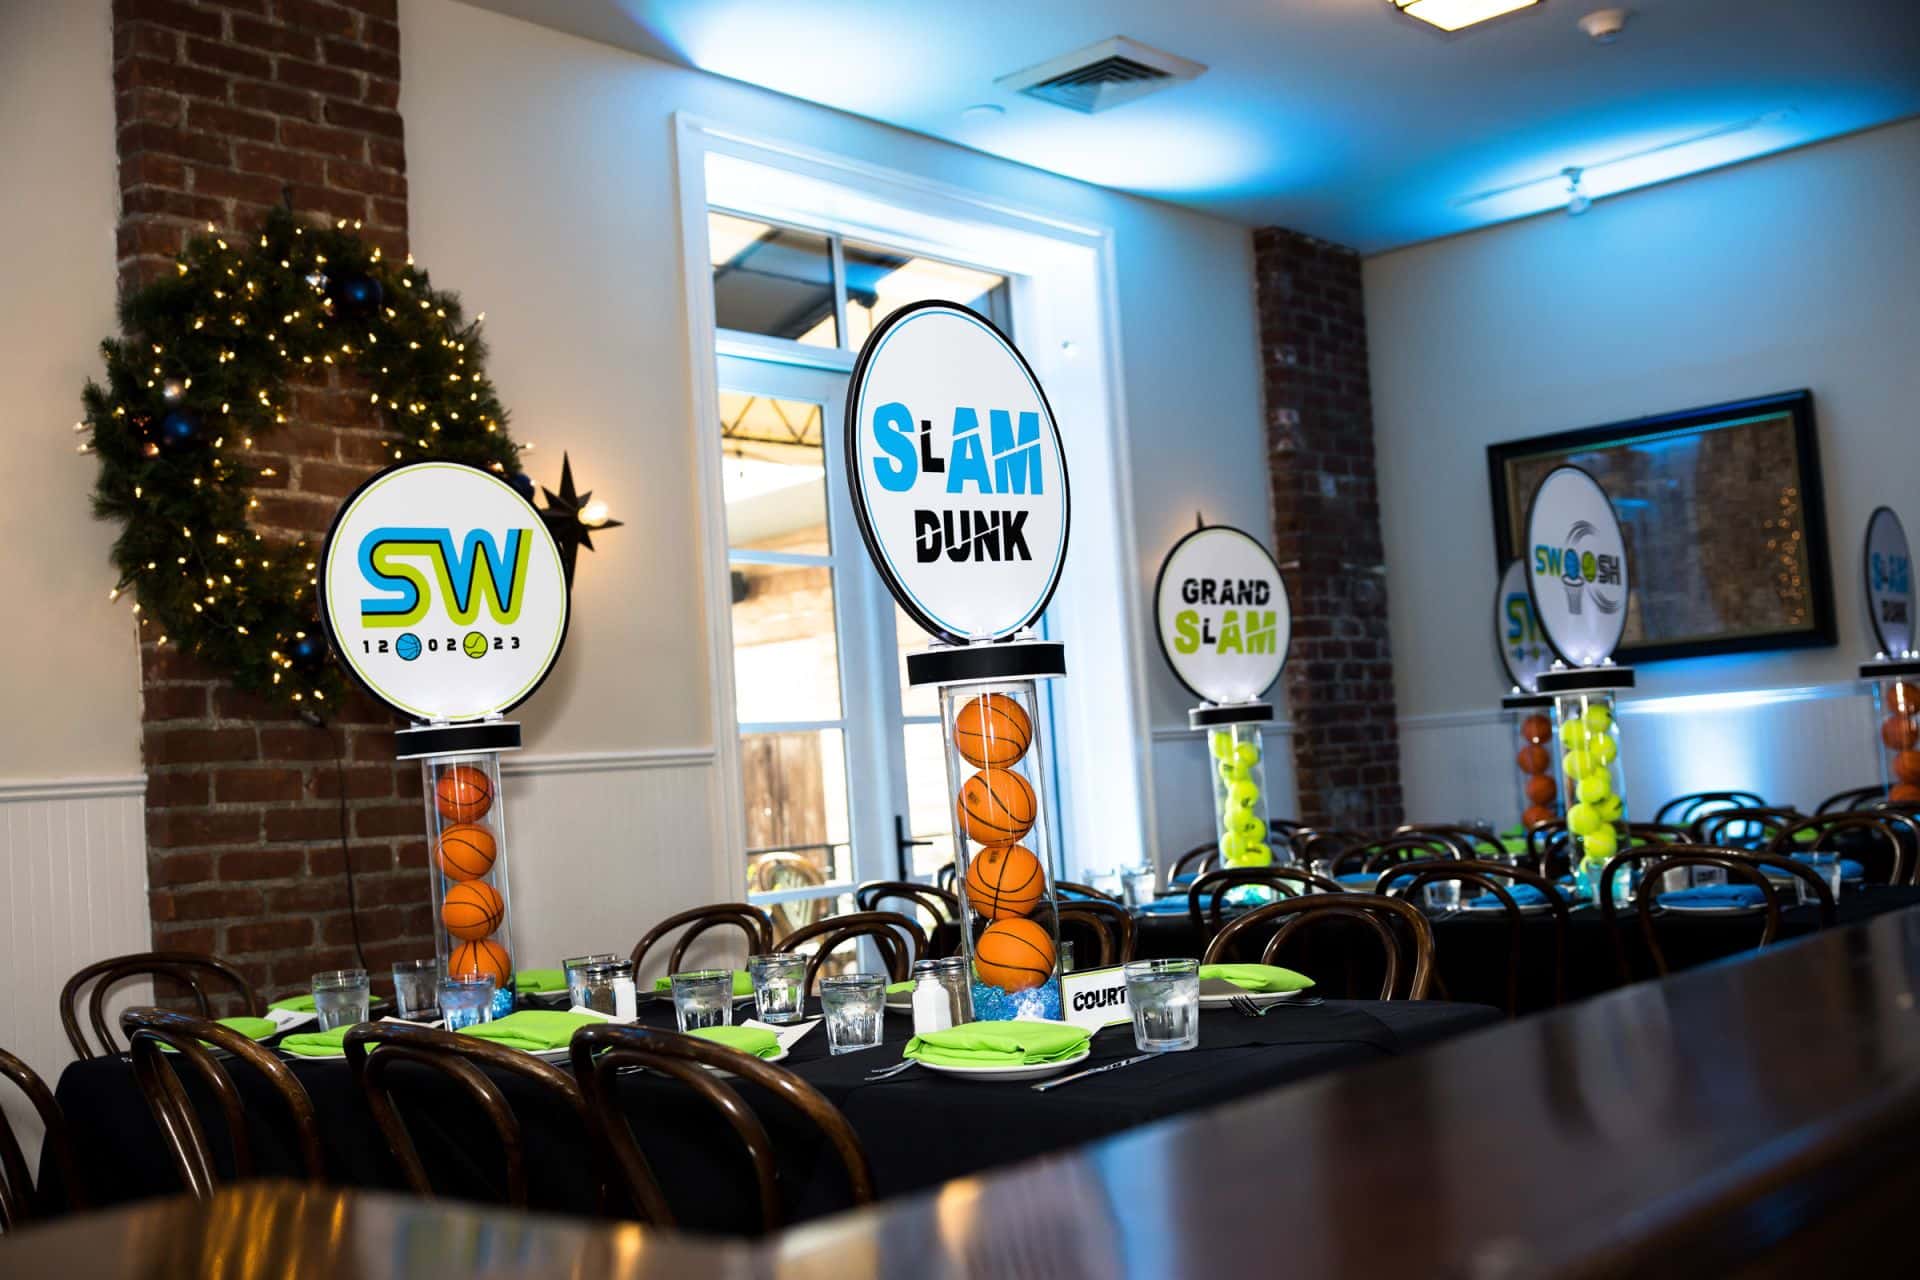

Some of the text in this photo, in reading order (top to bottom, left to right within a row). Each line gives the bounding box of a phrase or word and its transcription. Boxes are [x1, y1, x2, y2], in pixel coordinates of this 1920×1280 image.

[872, 402, 1044, 495] SLAM
[914, 510, 1033, 563] DUNK
[358, 527, 533, 628] SW
[1182, 578, 1270, 606] GRAND
[1174, 609, 1277, 655] SLAM
[1073, 985, 1130, 1012] COURT
